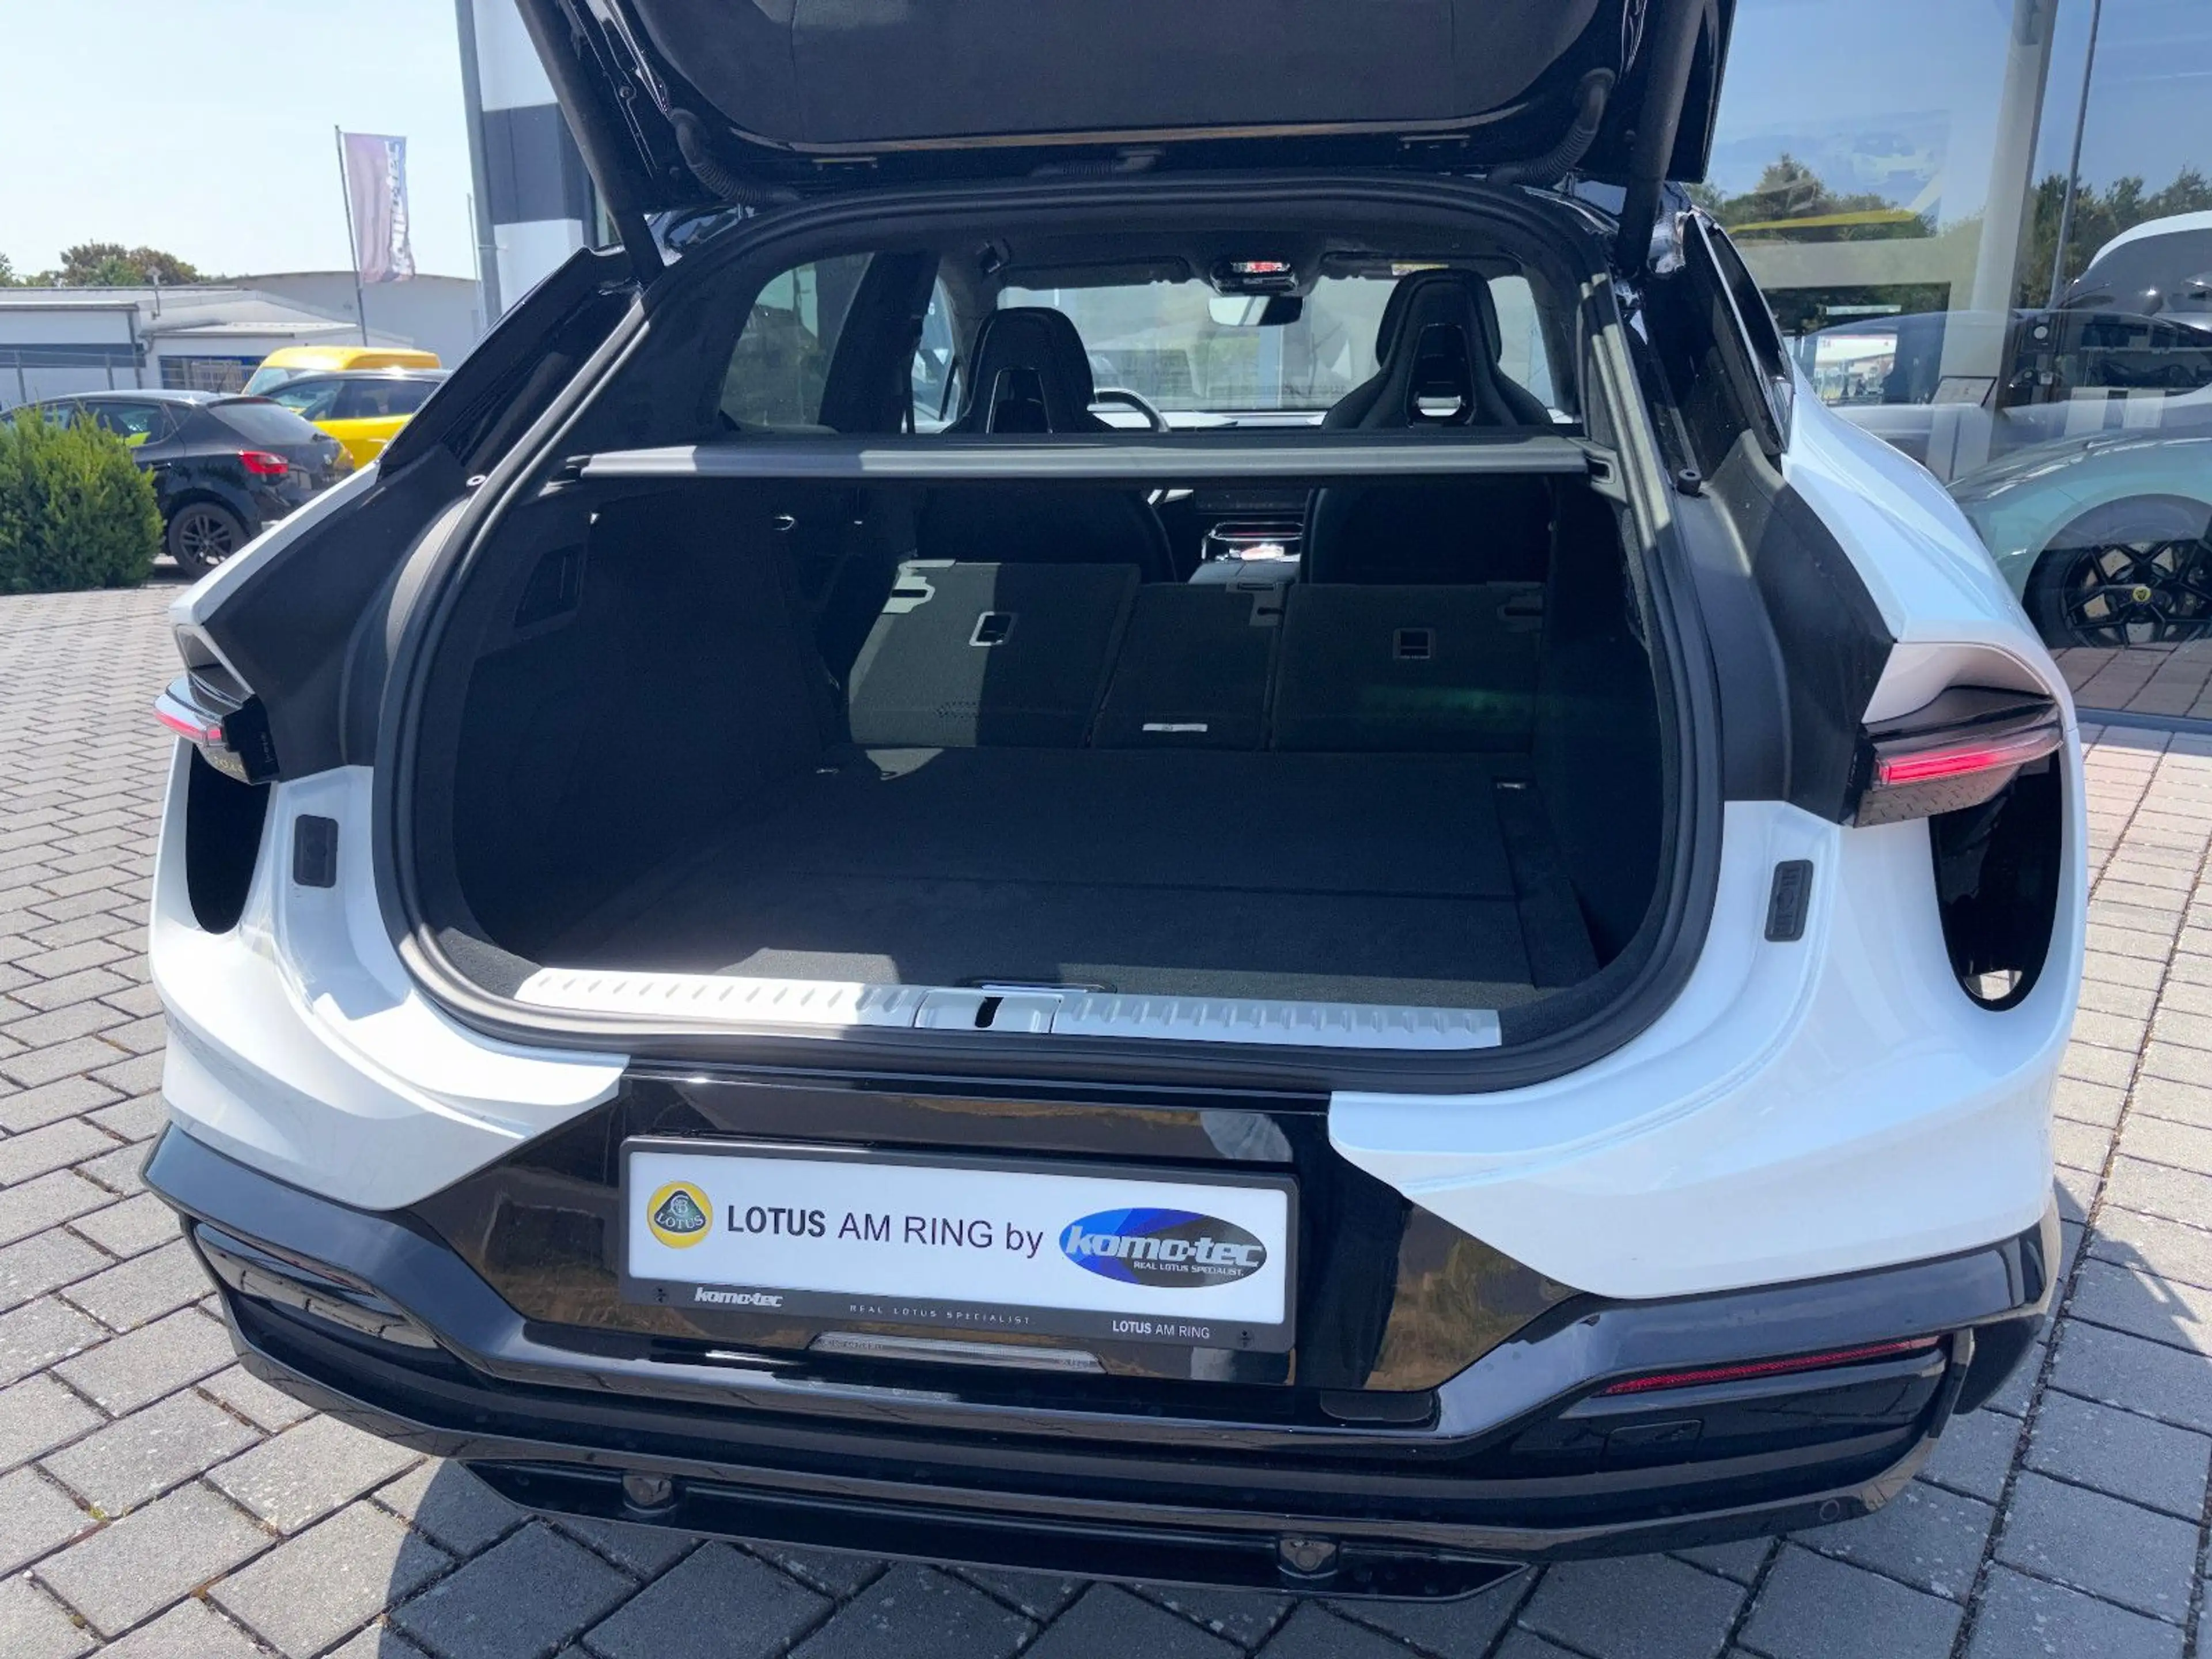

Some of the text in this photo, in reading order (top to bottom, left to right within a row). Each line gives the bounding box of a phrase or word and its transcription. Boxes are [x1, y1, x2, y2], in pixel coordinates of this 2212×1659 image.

[657, 1213, 704, 1229] LOTUS
[728, 1205, 1043, 1259] LOTUS AM RING by
[1133, 1260, 1157, 1270] REAL
[1160, 1263, 1188, 1272] LOTUS
[850, 1305, 1031, 1324] REAL LOTUS SPECIALIST
[1112, 1320, 1210, 1339] LOTUS AM RING
